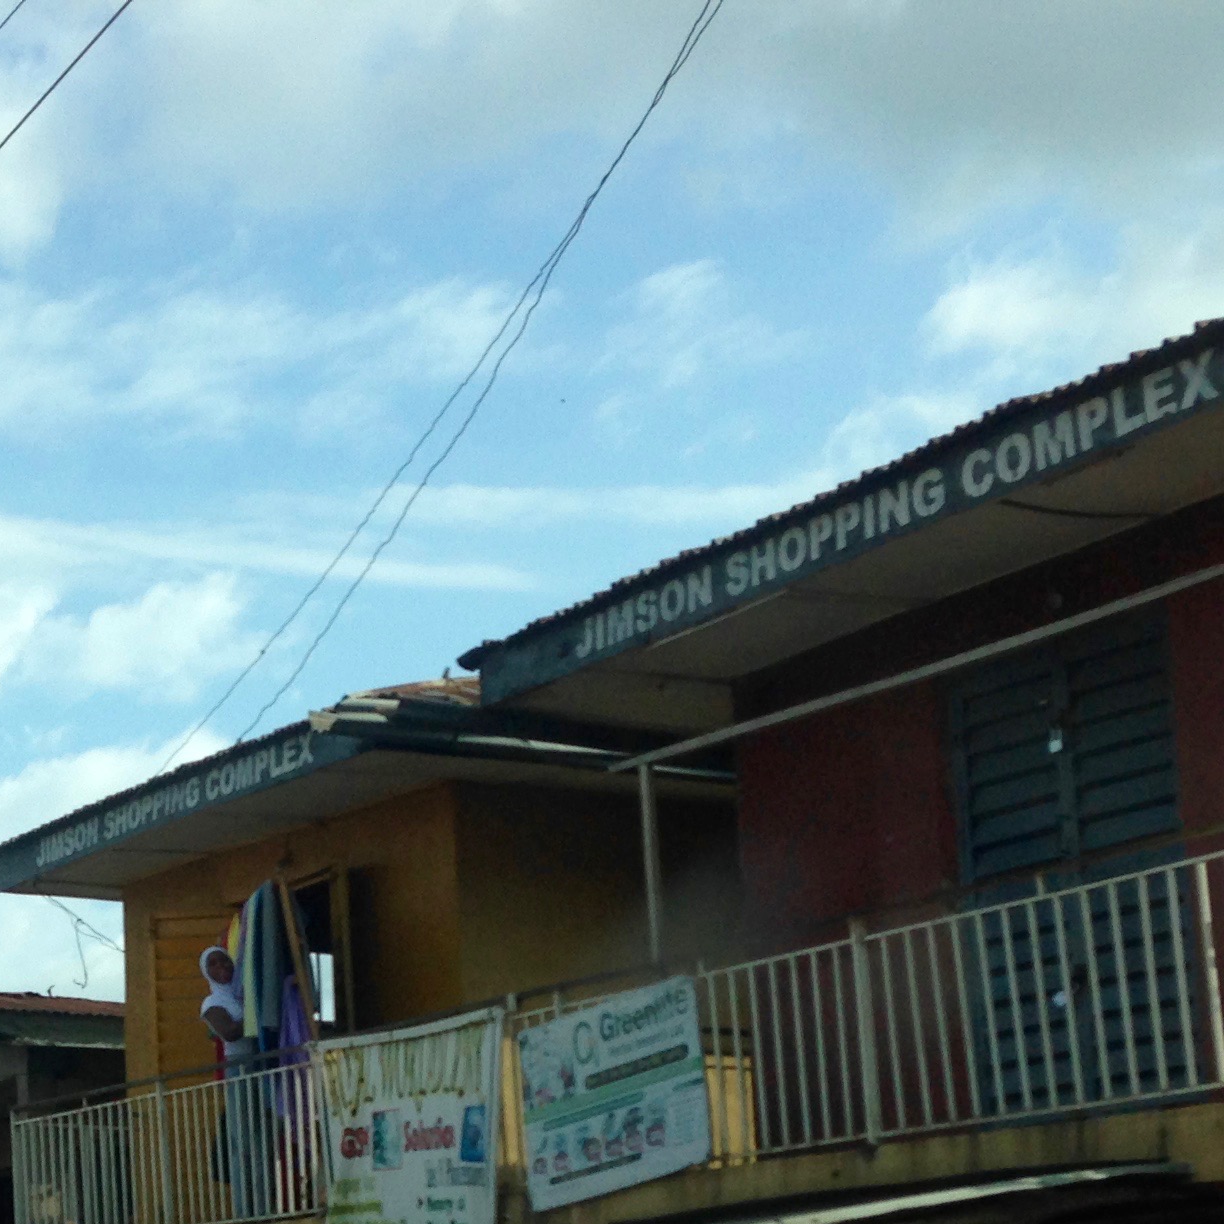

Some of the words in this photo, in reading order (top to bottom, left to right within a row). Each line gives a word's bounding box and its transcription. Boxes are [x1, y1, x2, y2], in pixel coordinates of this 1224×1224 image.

[576, 567, 712, 658] JIMSON
[724, 467, 946, 597] SHOPPING
[961, 348, 1220, 499] COMPLEX
[36, 819, 98, 867] JIMSON
[103, 777, 201, 840] SHOPPING
[205, 732, 314, 801] COMPLEX
